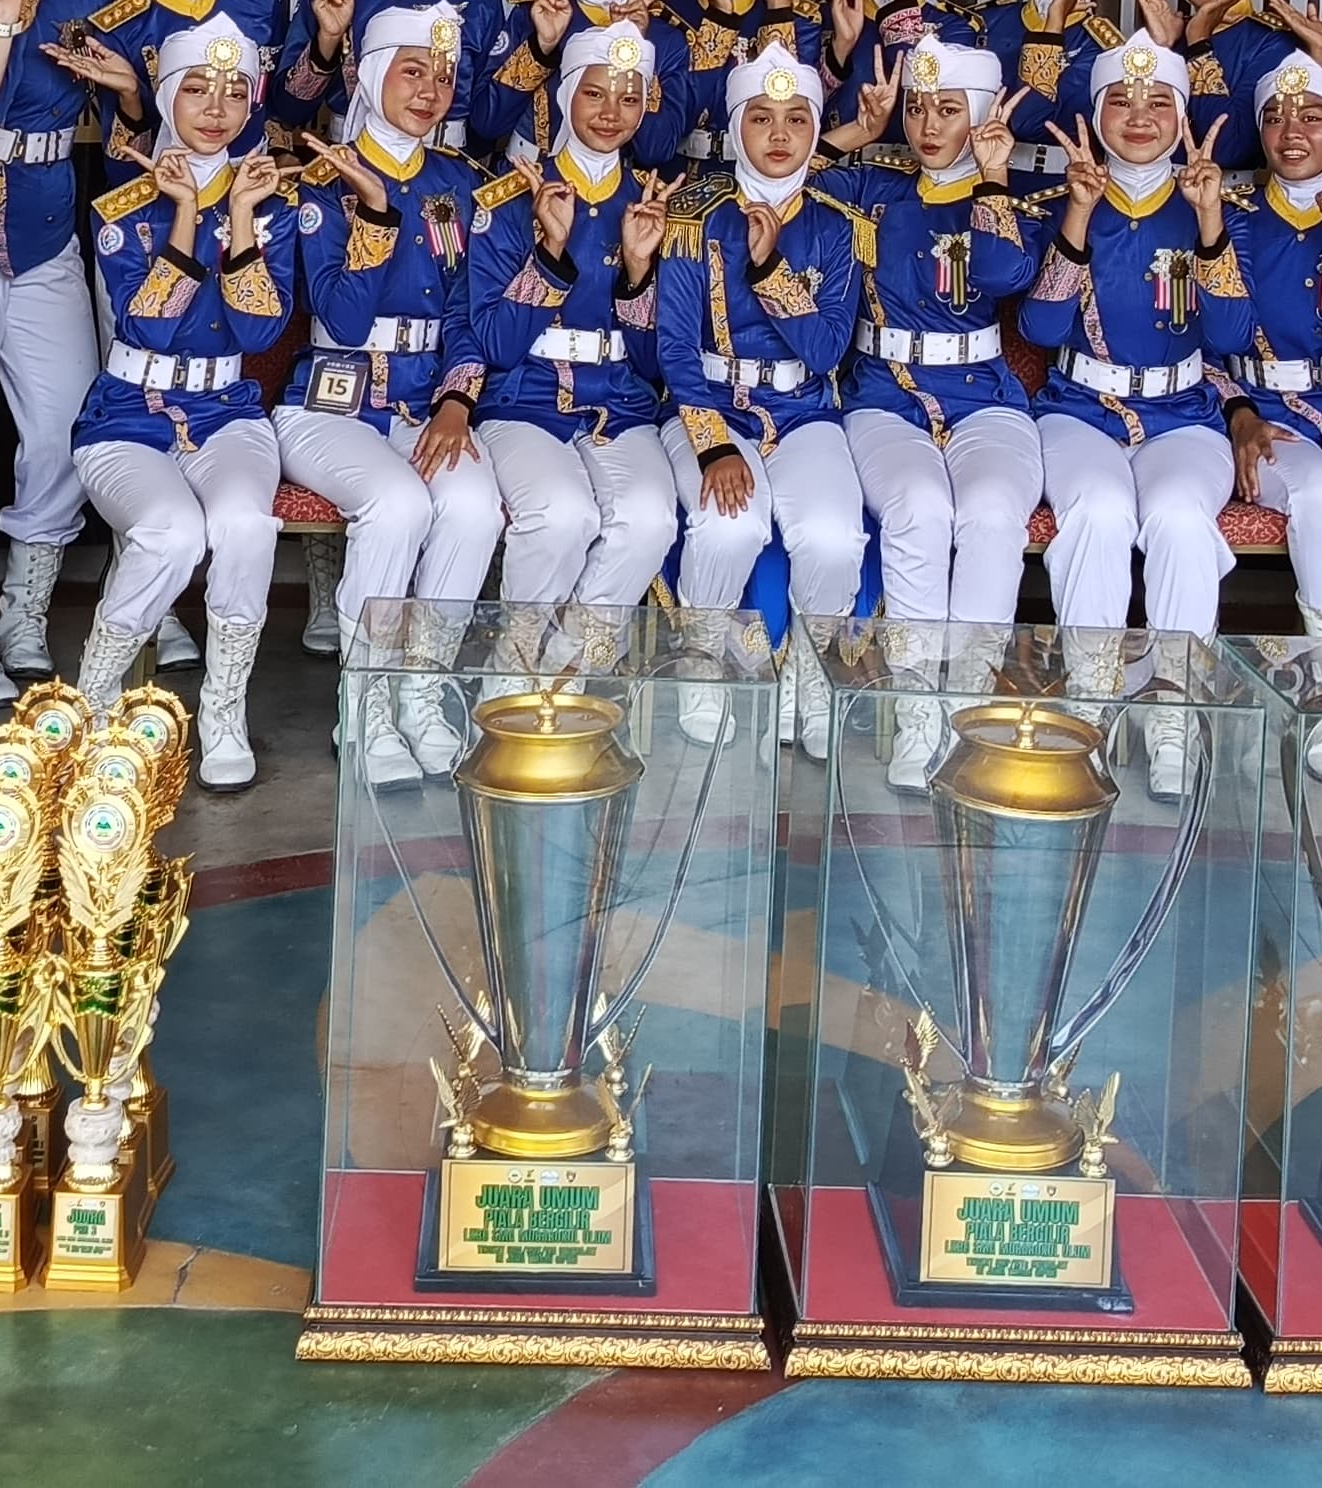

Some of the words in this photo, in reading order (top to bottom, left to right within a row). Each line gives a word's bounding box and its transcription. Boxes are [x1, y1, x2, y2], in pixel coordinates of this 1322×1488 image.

[326, 377, 348, 396] 15
[475, 1184, 534, 1209] JUARA
[540, 1185, 600, 1210] UMUM
[483, 1210, 524, 1229] PIALA
[529, 1210, 590, 1230] BERGILIR
[957, 1197, 1015, 1222] JUARA
[1020, 1199, 1080, 1225] UMUM
[965, 1221, 1005, 1241] PIALA
[1010, 1223, 1070, 1244] BERGILIR
